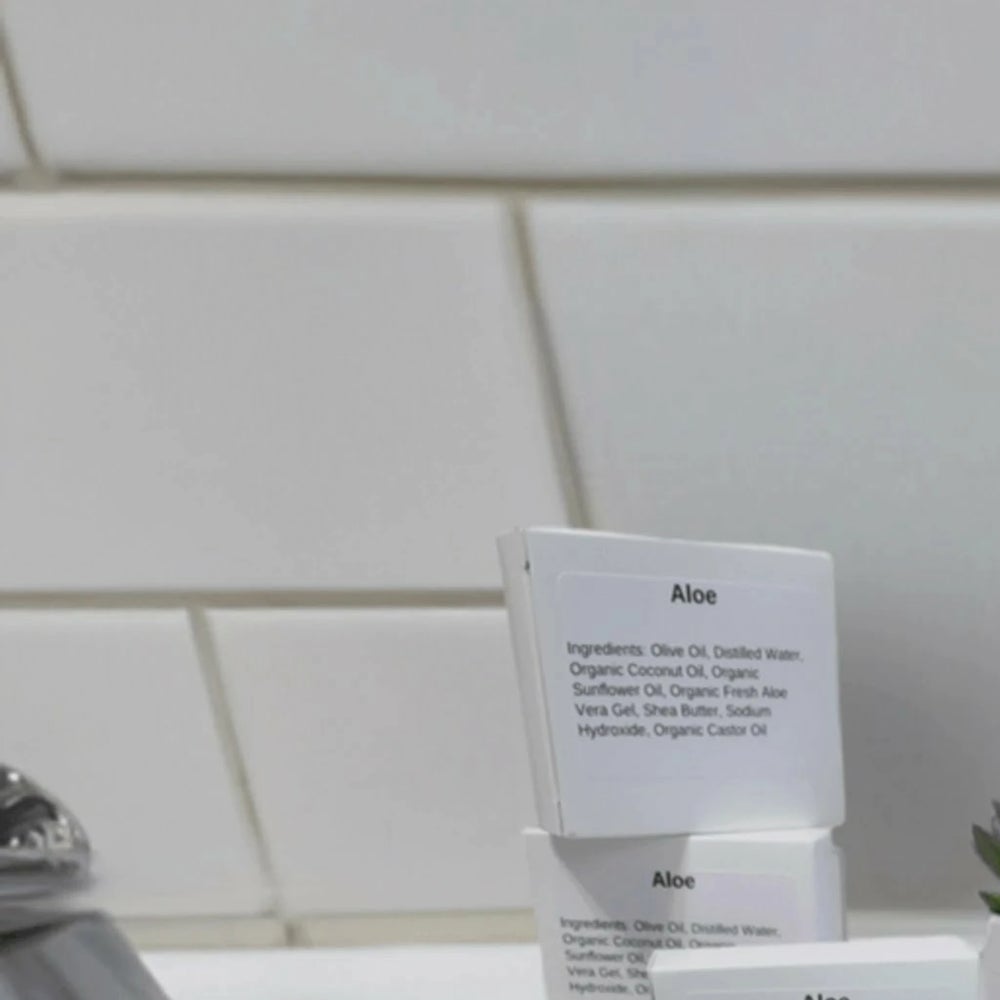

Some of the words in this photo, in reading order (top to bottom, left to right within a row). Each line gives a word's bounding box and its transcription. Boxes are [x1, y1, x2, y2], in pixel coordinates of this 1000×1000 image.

[671, 584, 717, 604] Aloe
[650, 643, 684, 658] Olive
[688, 645, 710, 660] Oil,
[714, 646, 762, 660] Distilled
[765, 649, 804, 662] Water,
[570, 662, 623, 678] Organic
[627, 663, 683, 678] Coconut
[686, 664, 708, 679] Oil,
[712, 666, 759, 681] Organic
[573, 683, 640, 696] Sunflower
[644, 684, 666, 698] Oil,
[670, 684, 719, 700] Organic
[724, 686, 758, 698] Fresh
[762, 687, 788, 699] Aloe
[575, 704, 608, 717] Vera
[612, 704, 639, 718] Gel,
[643, 704, 677, 717] Shea
[682, 705, 722, 718] Butter,
[726, 706, 770, 717] Sodium
[578, 724, 650, 740] Hydroxide,
[654, 724, 704, 738] Organic
[708, 724, 747, 736] Castor
[751, 724, 766, 736] Oil
[652, 871, 695, 888] Aloe
[634, 920, 664, 932] Olive
[692, 923, 739, 936] Distilled
[562, 933, 609, 947] Organic
[565, 950, 624, 962] Sunflower
[566, 965, 595, 976] Vera
[627, 968, 648, 978] She
